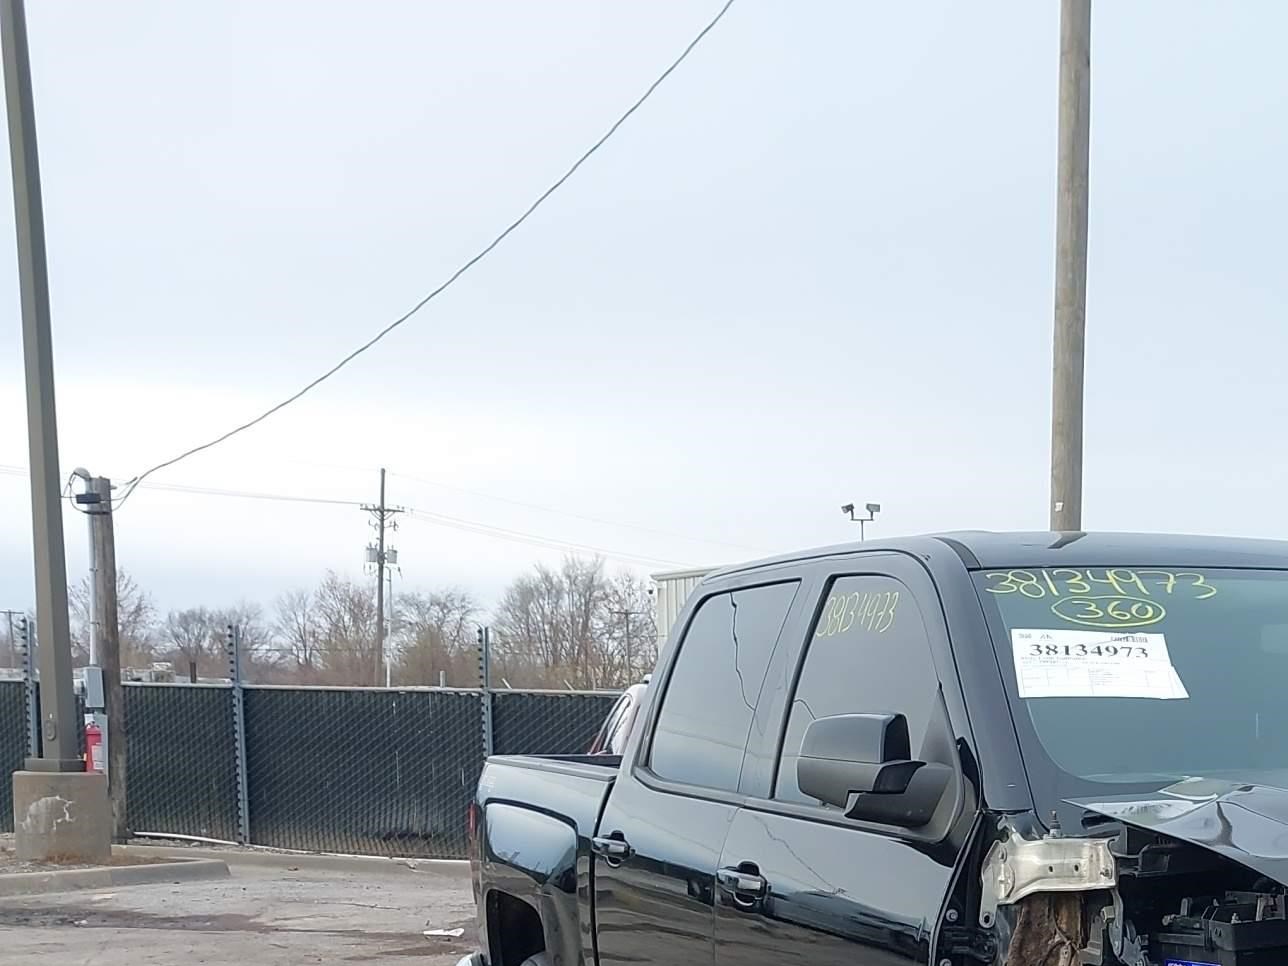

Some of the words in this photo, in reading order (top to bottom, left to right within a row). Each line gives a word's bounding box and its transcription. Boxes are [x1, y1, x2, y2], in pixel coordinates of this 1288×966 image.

[984, 569, 1217, 599] 38134973
[1071, 600, 1154, 620] 360
[1029, 643, 1149, 659] 38134973
